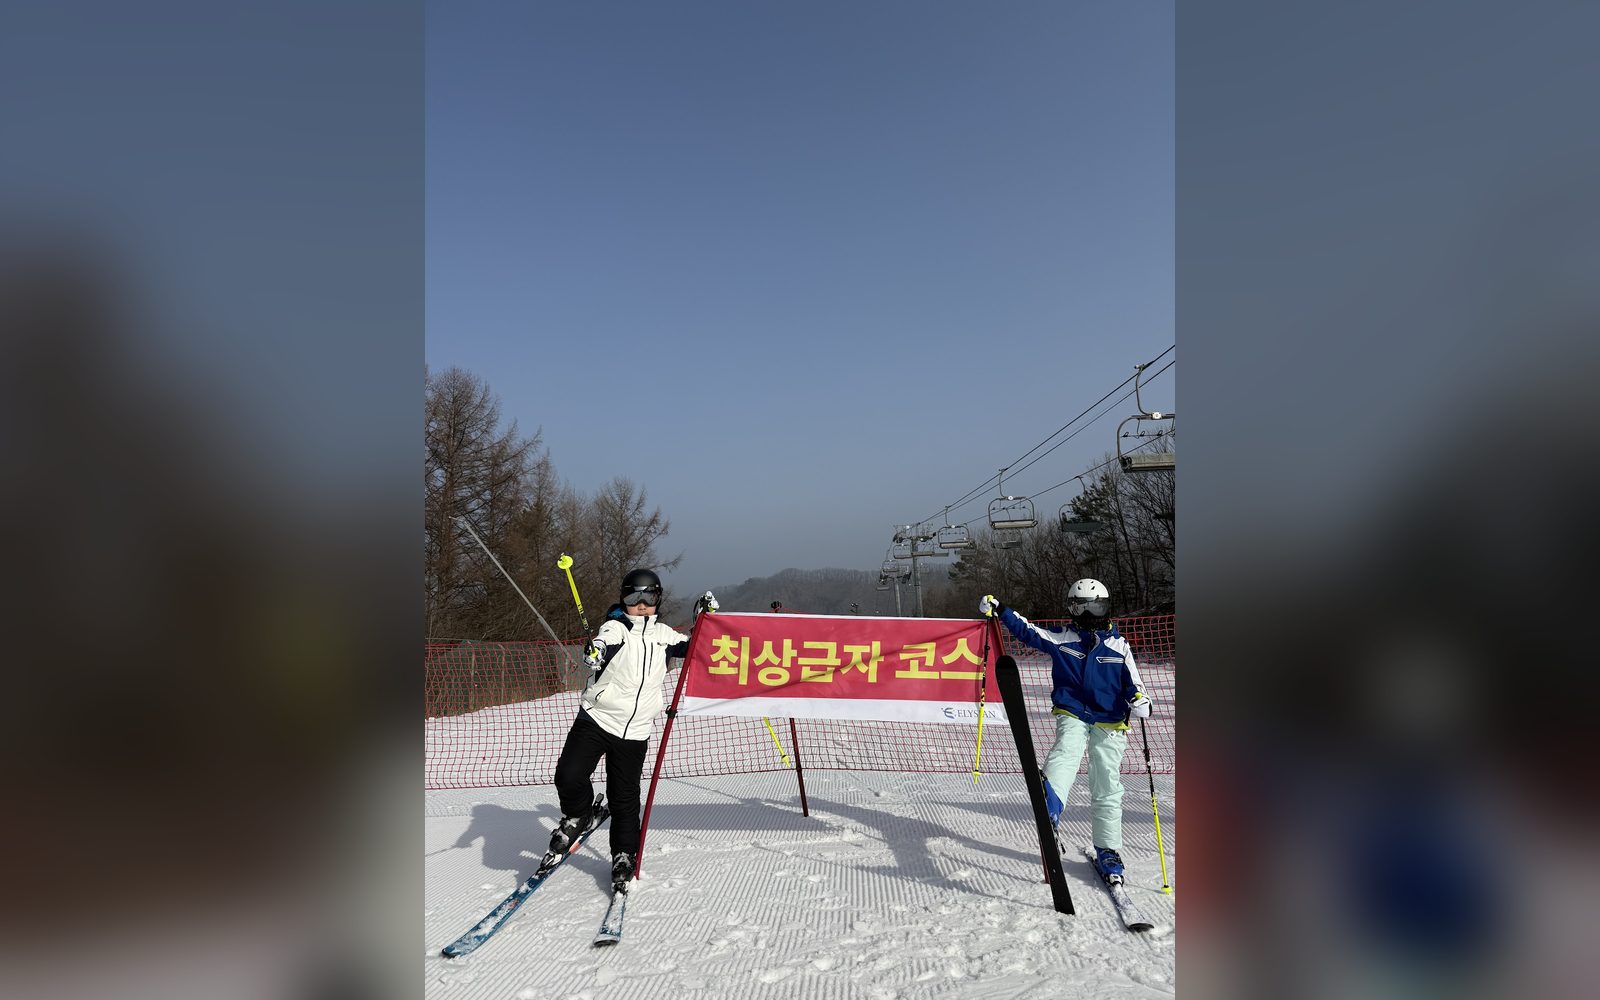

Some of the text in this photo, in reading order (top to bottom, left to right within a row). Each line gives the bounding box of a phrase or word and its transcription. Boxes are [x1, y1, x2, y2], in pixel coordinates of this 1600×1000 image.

[708, 635, 986, 686] 최상급자 코스
[957, 709, 996, 718] ELYSAN
